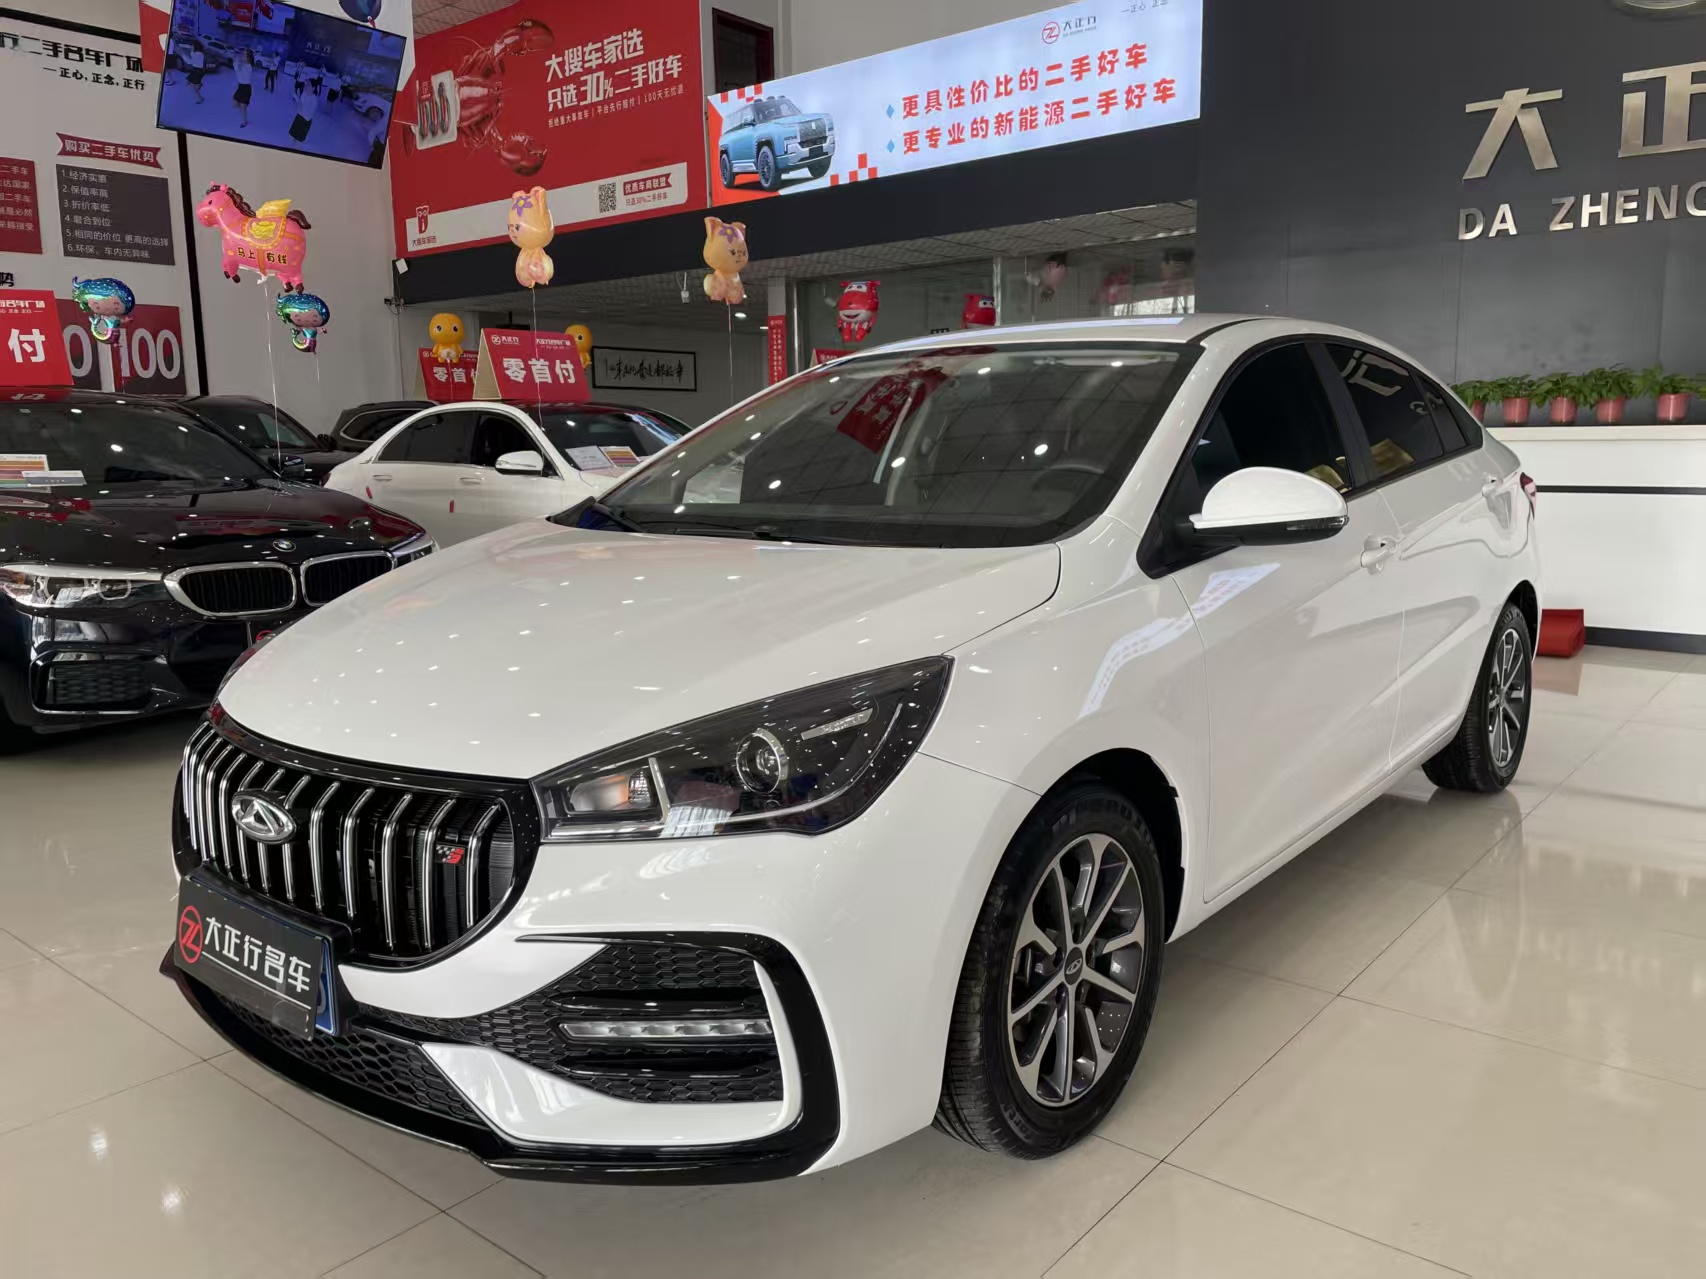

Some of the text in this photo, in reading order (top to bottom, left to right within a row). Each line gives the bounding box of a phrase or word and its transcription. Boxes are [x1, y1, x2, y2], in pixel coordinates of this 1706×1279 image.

[545, 28, 644, 82] 大搜车家选
[547, 55, 683, 112] 只选30%二手好车
[902, 43, 1148, 119] 更具性价比的二手好车
[903, 78, 1177, 155] 更专业的新能源二手好车
[1462, 61, 1706, 180] 大正
[64, 139, 155, 163] 购买二手车优势
[64, 200, 111, 214] 3.折价率低
[1458, 181, 1706, 241] DA ZHENG
[8, 328, 46, 363] 付
[503, 358, 576, 384] 零首付
[204, 917, 312, 992] 大正行名车
